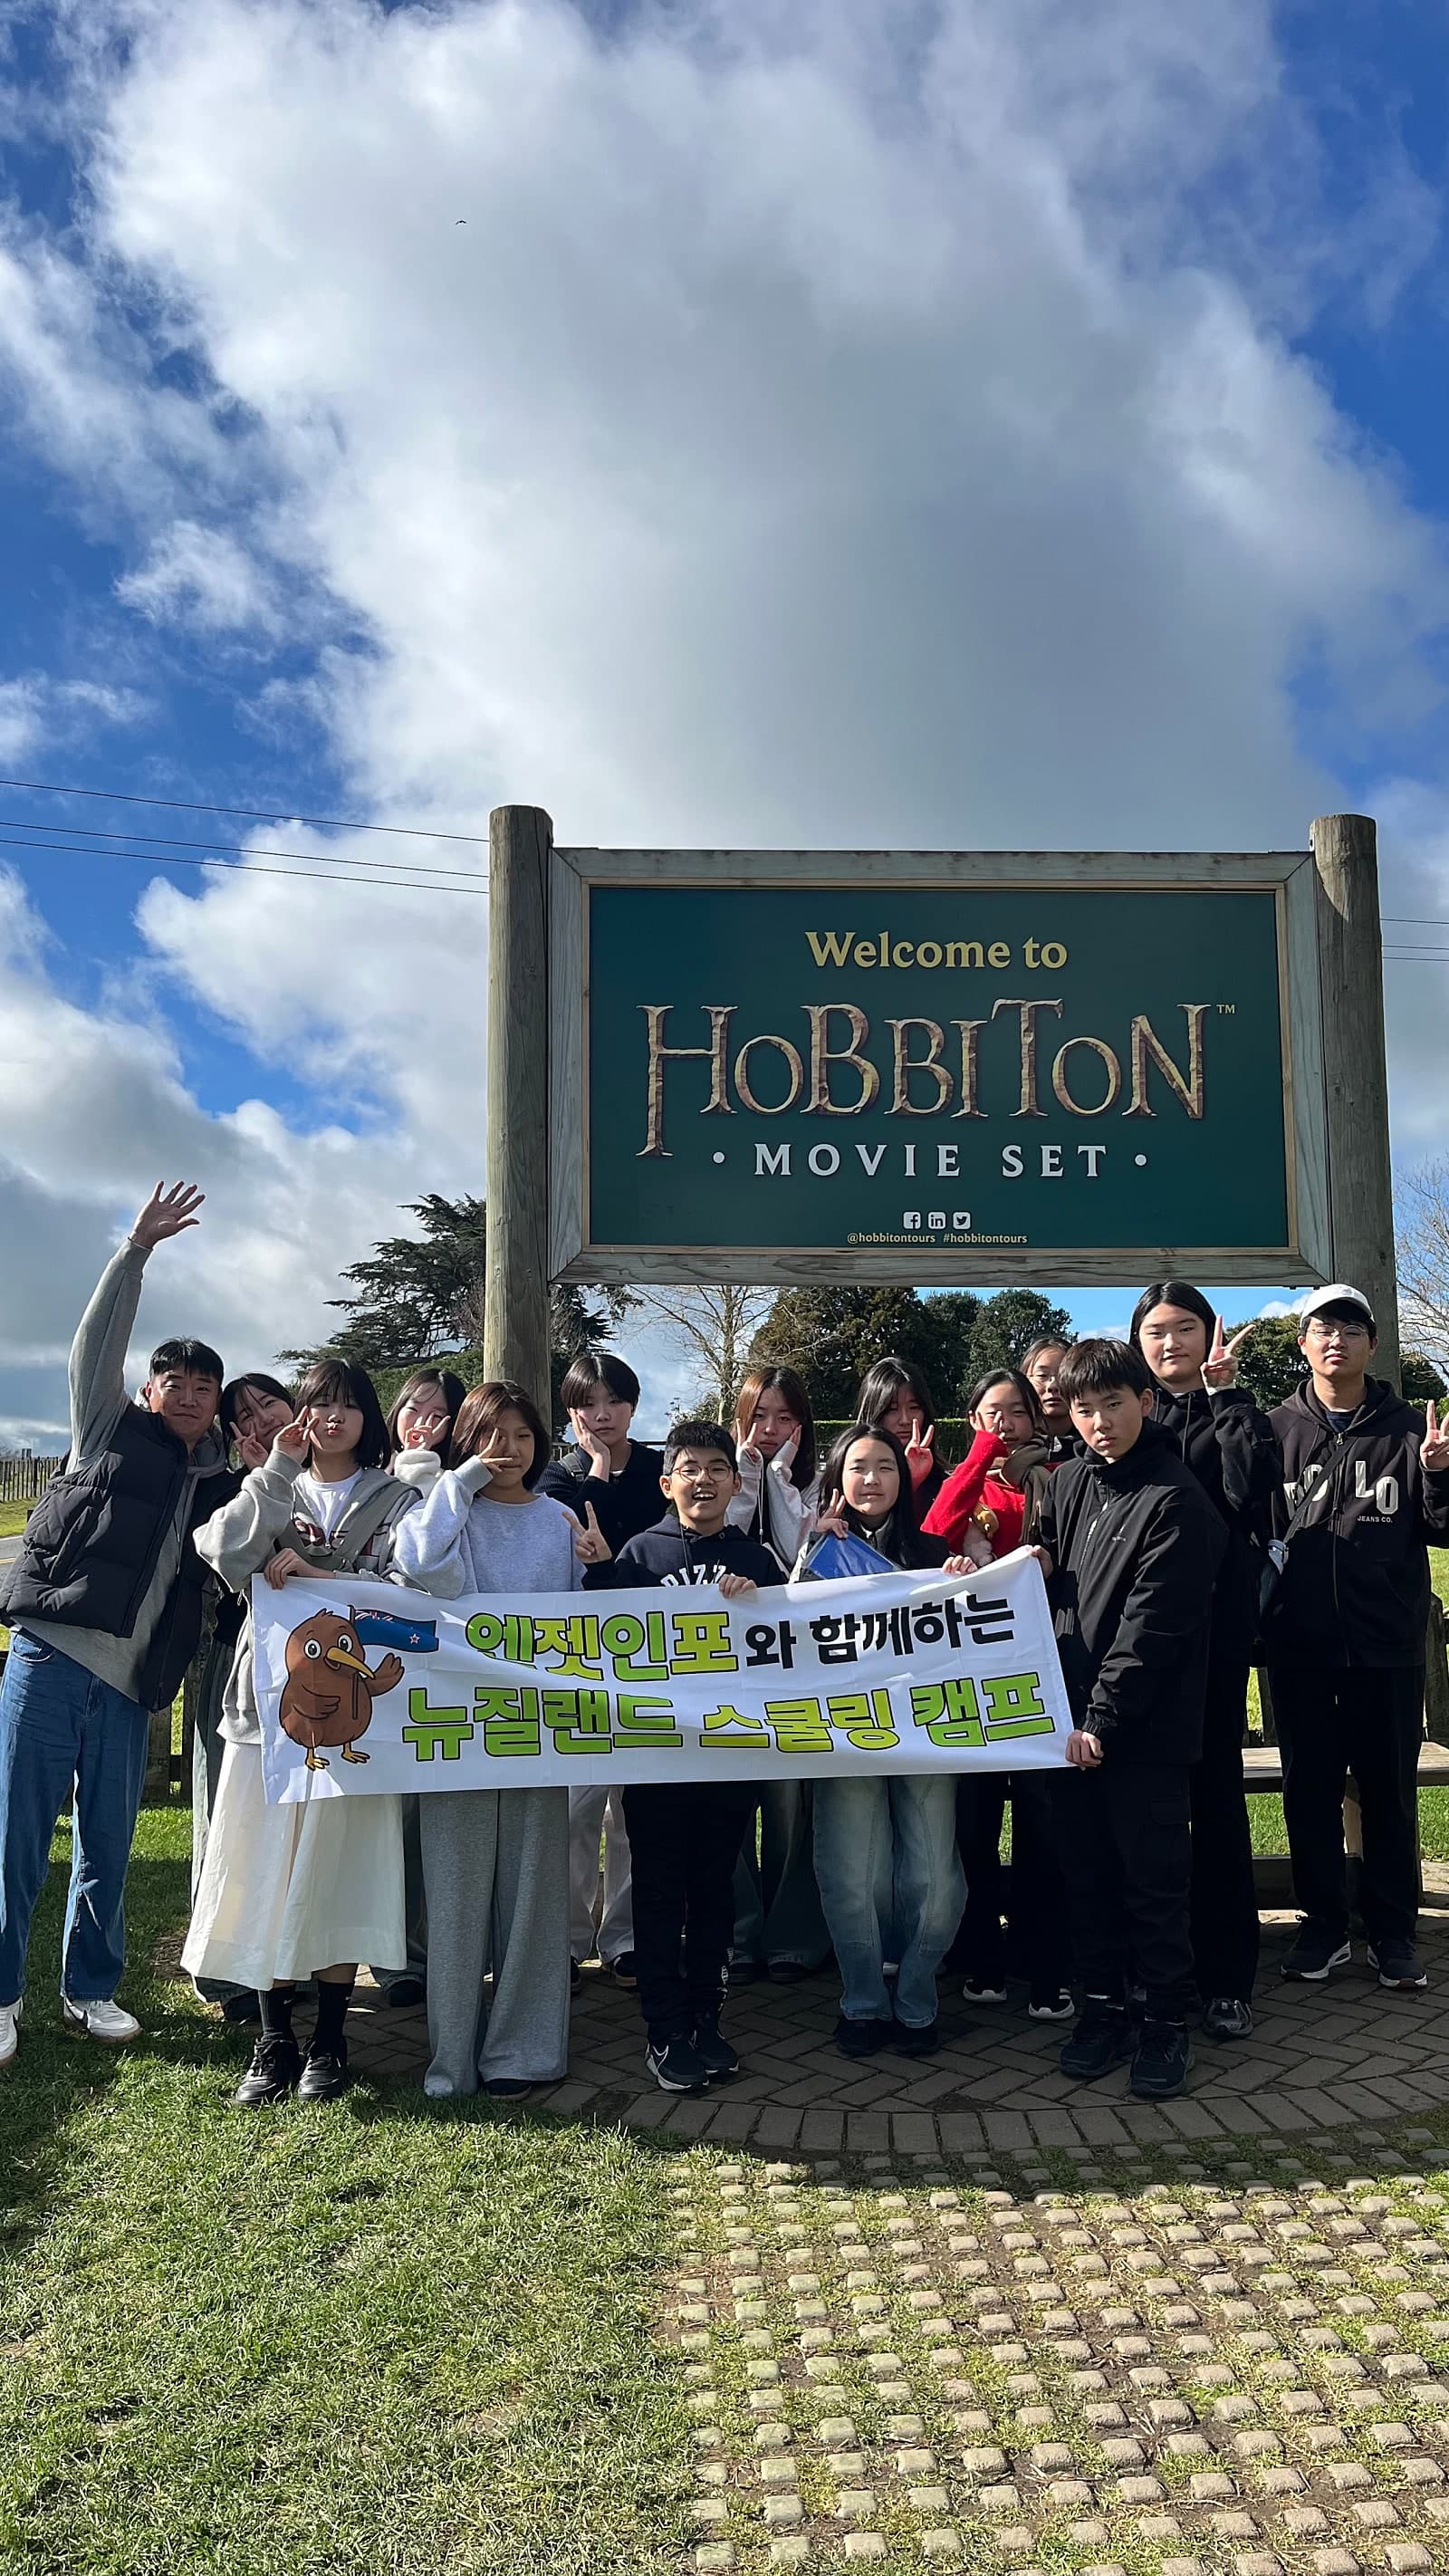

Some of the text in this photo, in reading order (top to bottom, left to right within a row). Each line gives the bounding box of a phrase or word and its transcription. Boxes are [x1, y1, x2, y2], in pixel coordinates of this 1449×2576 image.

[804, 931, 1068, 968] Welcome to
[753, 1143, 1107, 1177] MOVIE SET
[847, 1233, 1028, 1245] @hobbitontours #hobbitontours
[809, 1593, 1014, 1665] 함께하는
[402, 1672, 1055, 1762] 뉴질랜드 스쿨링 캠프
